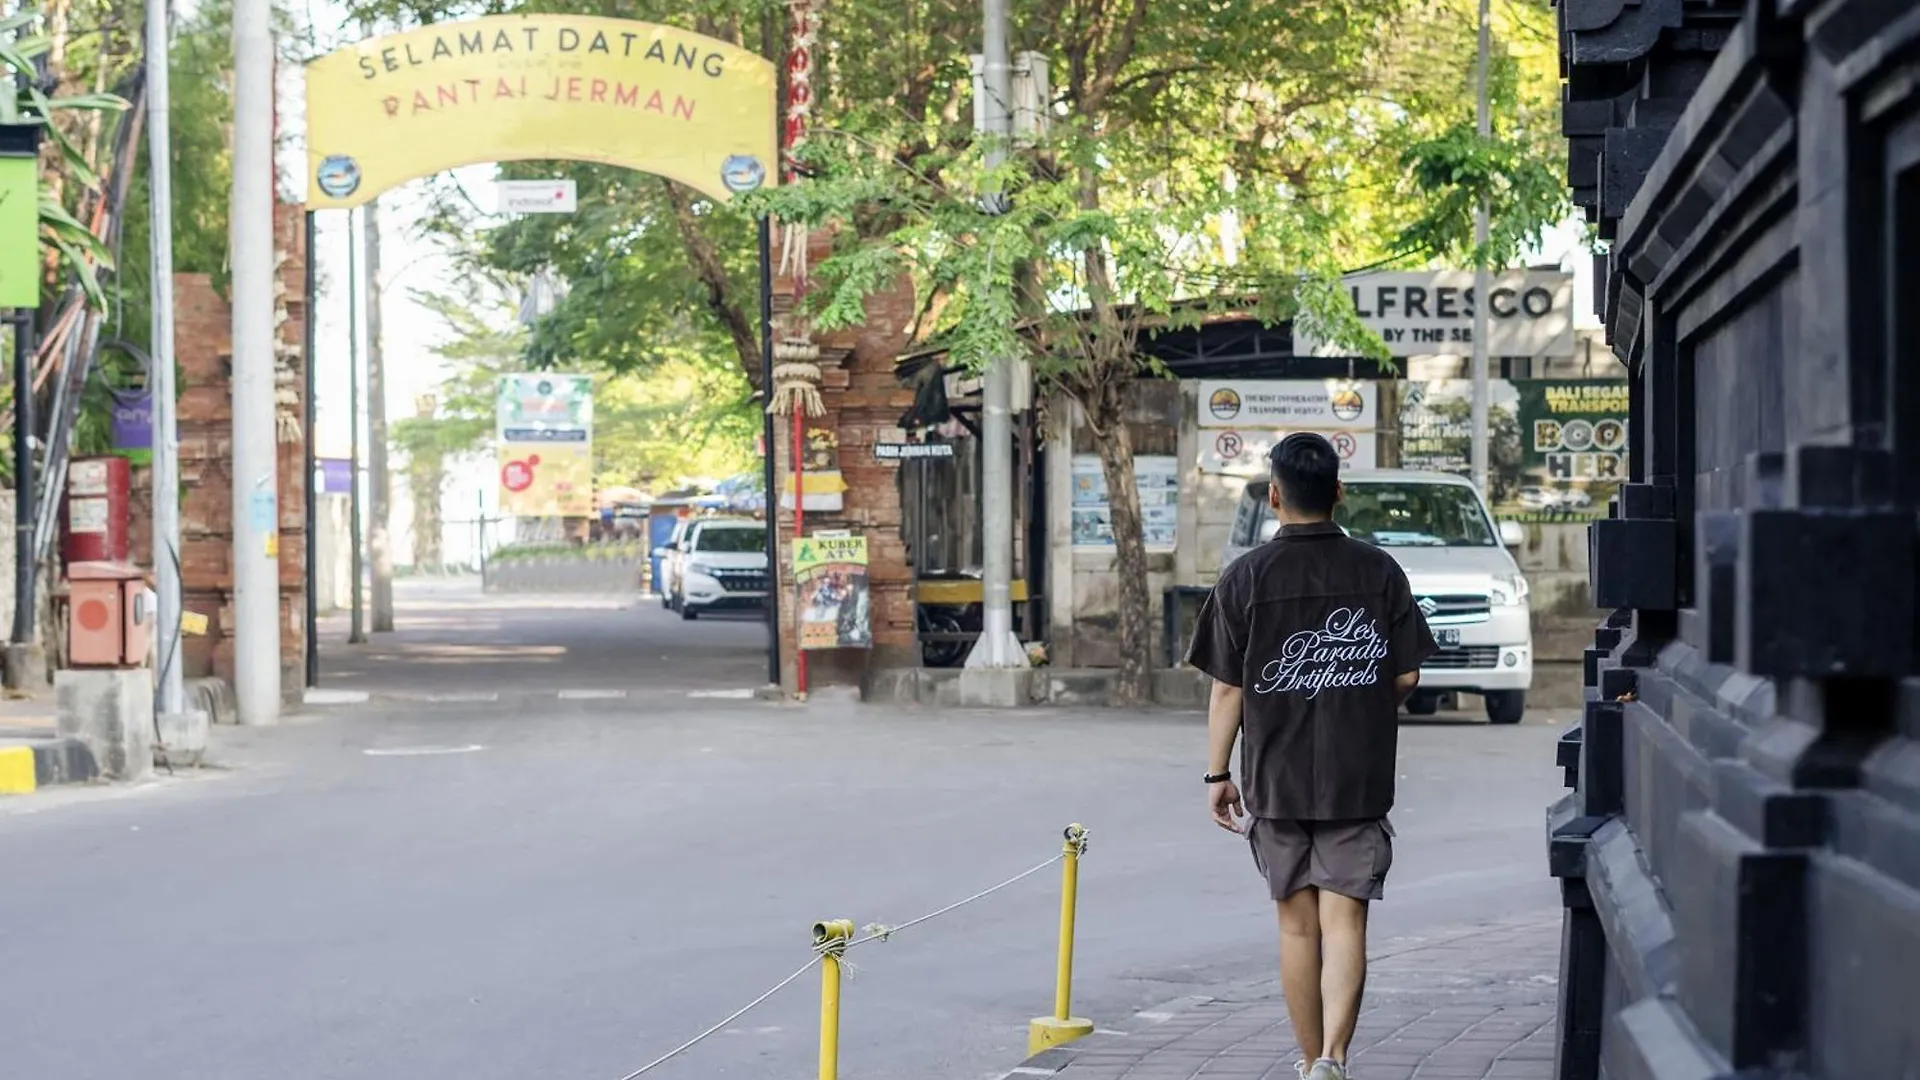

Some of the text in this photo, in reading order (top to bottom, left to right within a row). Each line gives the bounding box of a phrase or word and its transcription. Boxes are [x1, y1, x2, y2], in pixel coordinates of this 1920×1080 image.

[359, 27, 725, 80] SELAMAT DATANG
[383, 77, 696, 121] PANTAI JERMAN
[1383, 328, 1472, 343] BY THE SE
[1545, 386, 1580, 400] BALI
[1548, 399, 1629, 413] TRANSPOR
[1534, 418, 1629, 453] BOO
[818, 540, 863, 549] KUBER
[825, 549, 857, 559] ATV
[1321, 608, 1376, 642] Les
[1282, 630, 1388, 665] Paradis
[1254, 659, 1378, 700] Artificiels
